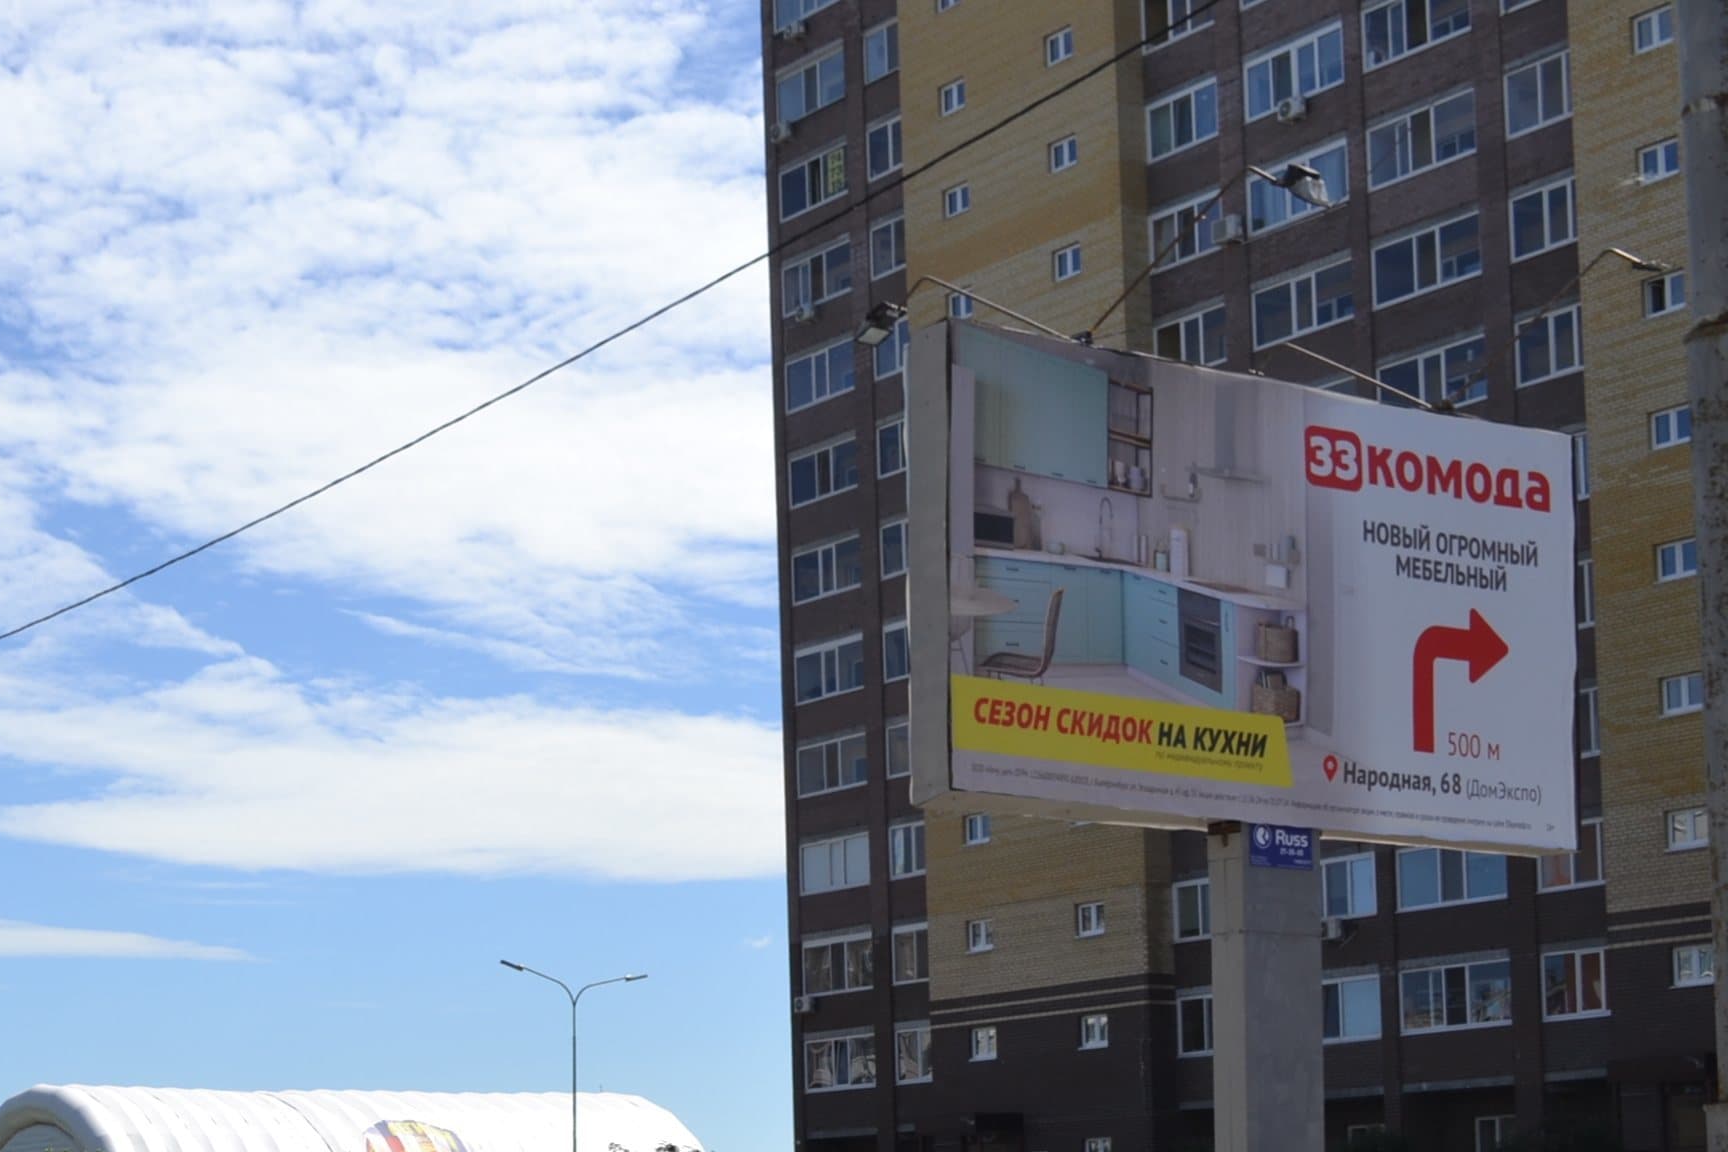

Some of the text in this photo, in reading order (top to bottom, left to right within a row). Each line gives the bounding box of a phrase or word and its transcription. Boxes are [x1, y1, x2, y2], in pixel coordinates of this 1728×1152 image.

[1309, 435, 1551, 513] 33 комода
[1363, 520, 1538, 567] НОВЫЙ ОГРОМНЫЙ
[1395, 555, 1507, 592] МЕБЕЛЬНЫЙ
[973, 697, 1268, 758] СЕЗОН СКИДОК НА КУХНИ
[1448, 732, 1500, 760] 500 м
[1343, 762, 1542, 806] Народная, 68 (ДомЭкспо)
